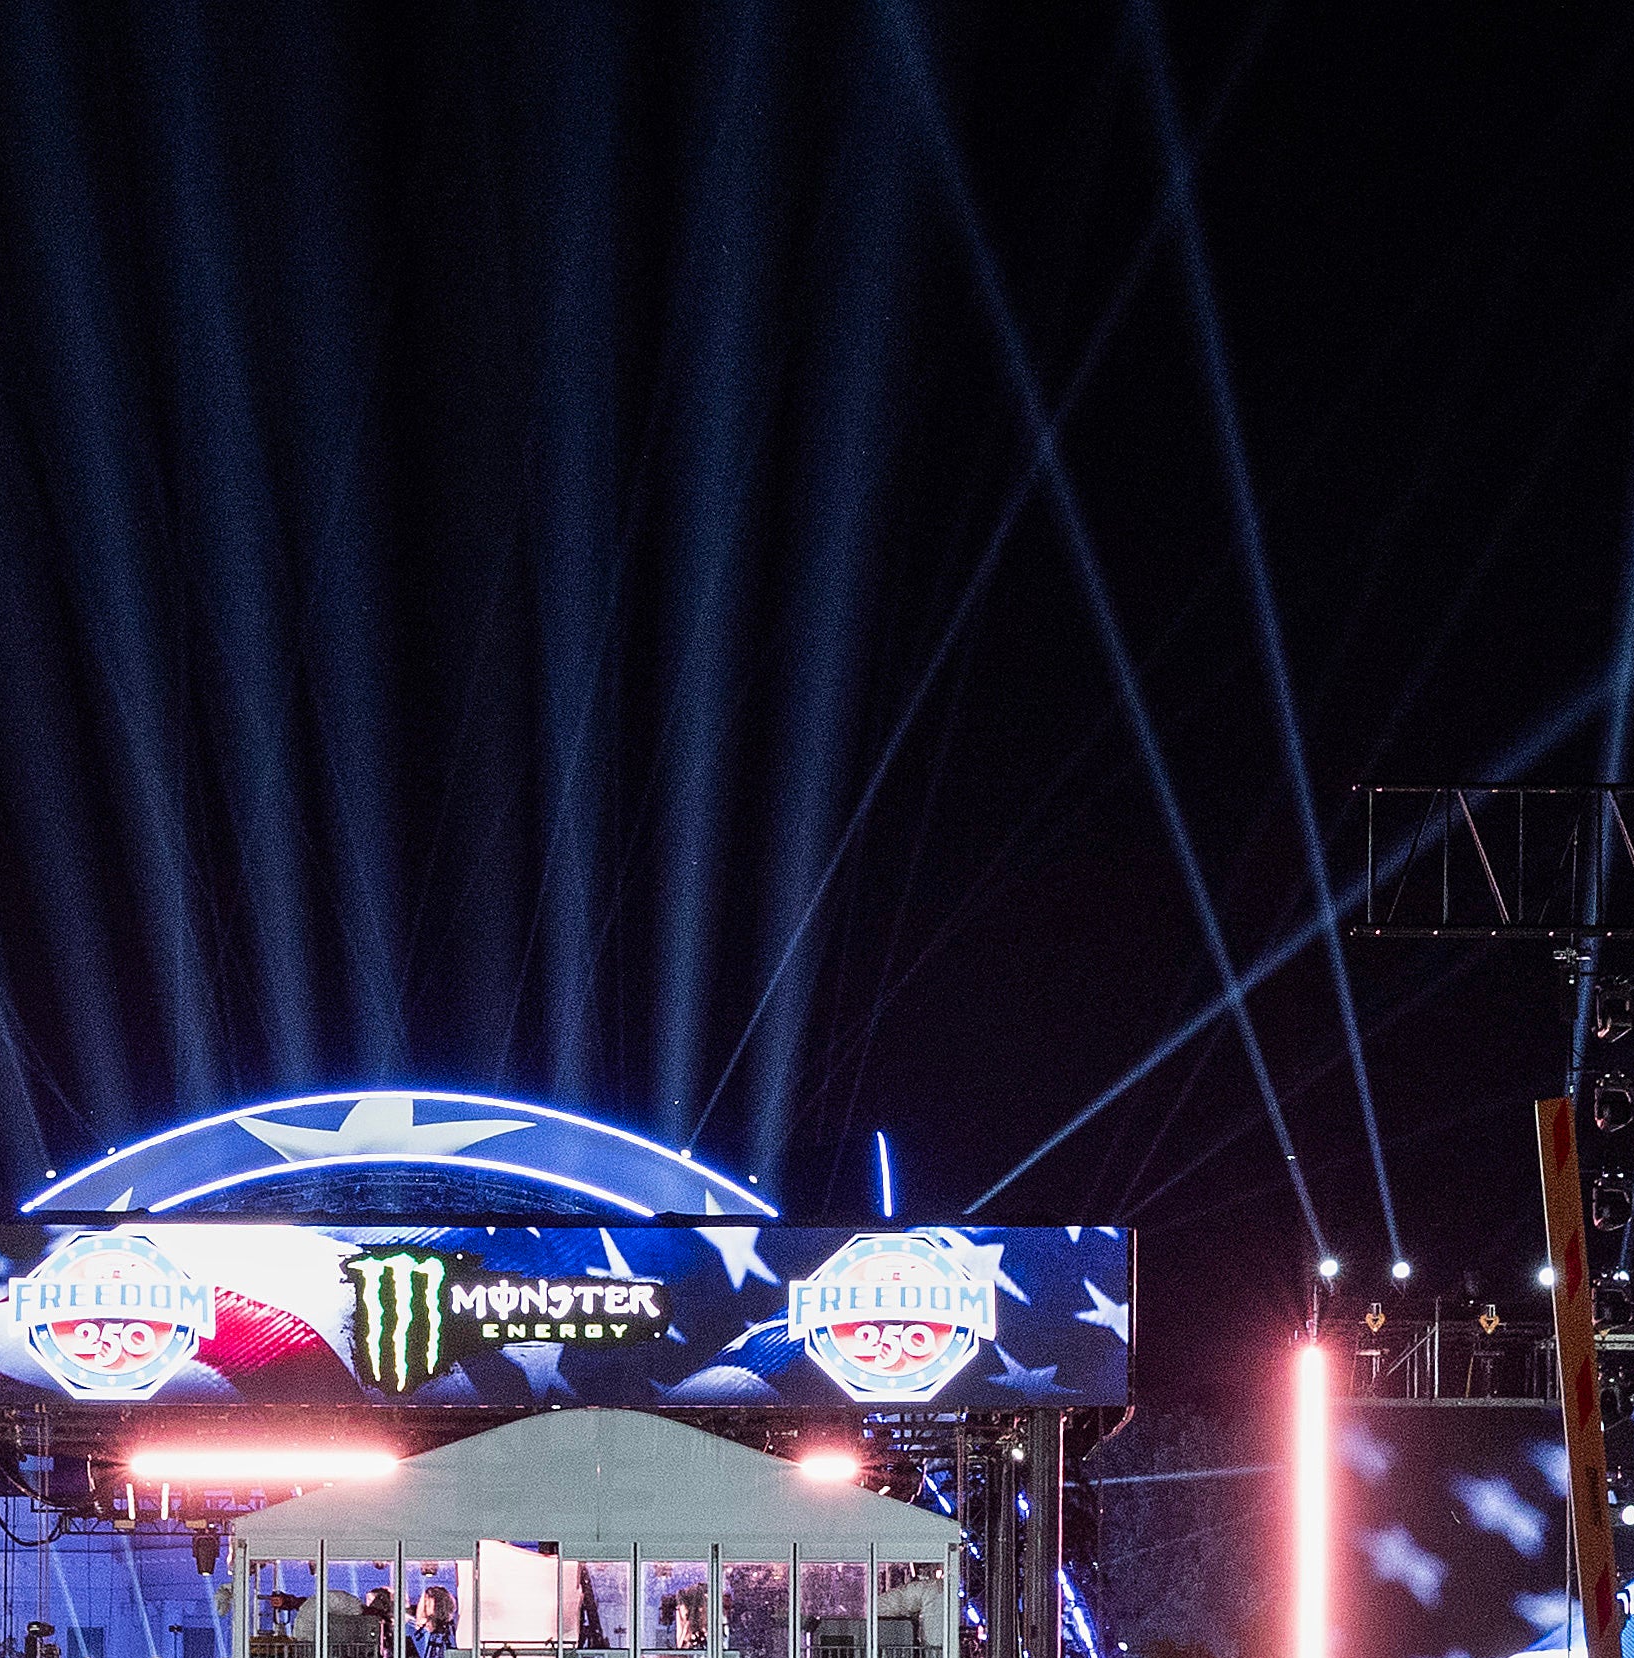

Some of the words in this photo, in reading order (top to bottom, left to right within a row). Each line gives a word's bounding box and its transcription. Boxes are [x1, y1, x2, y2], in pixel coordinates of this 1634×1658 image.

[15, 1282, 209, 1324] FREEDOM
[451, 1279, 661, 1320] MONSTER
[795, 1285, 989, 1326] FREEDOM
[73, 1321, 156, 1368] 250
[482, 1324, 628, 1339] ENERGY
[853, 1324, 936, 1371] 250
